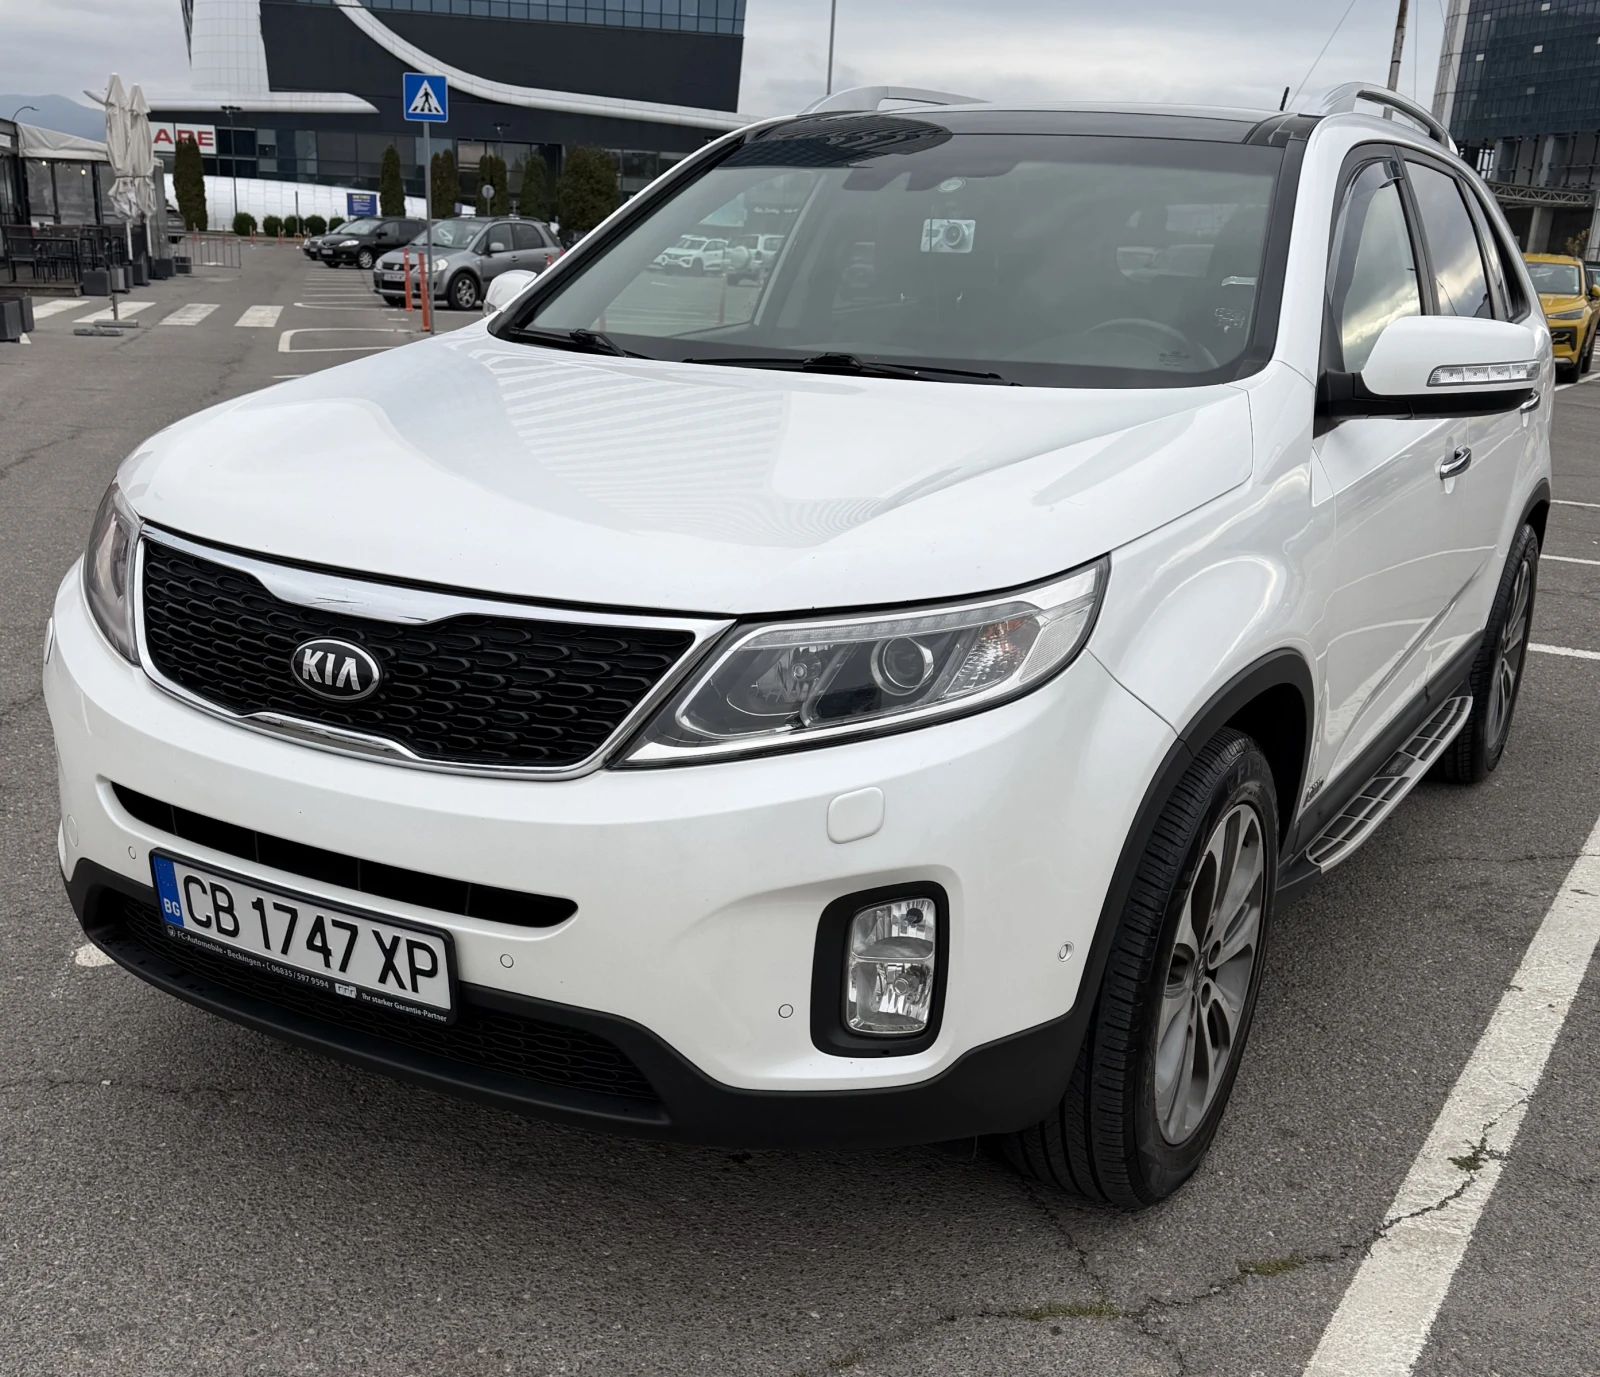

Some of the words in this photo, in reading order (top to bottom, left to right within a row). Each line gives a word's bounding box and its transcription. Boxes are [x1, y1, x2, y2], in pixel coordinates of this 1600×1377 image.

[302, 648, 361, 691] KIA
[163, 897, 181, 917] BG
[183, 874, 240, 938] CB
[251, 897, 359, 973] 1747
[372, 928, 438, 994] XP
[177, 930, 223, 954] FC-Automobile
[227, 949, 262, 967] Beckingen
[310, 977, 330, 989] 9594
[372, 996, 393, 1008] starker
[394, 1002, 448, 1022] Garantie-Partner
